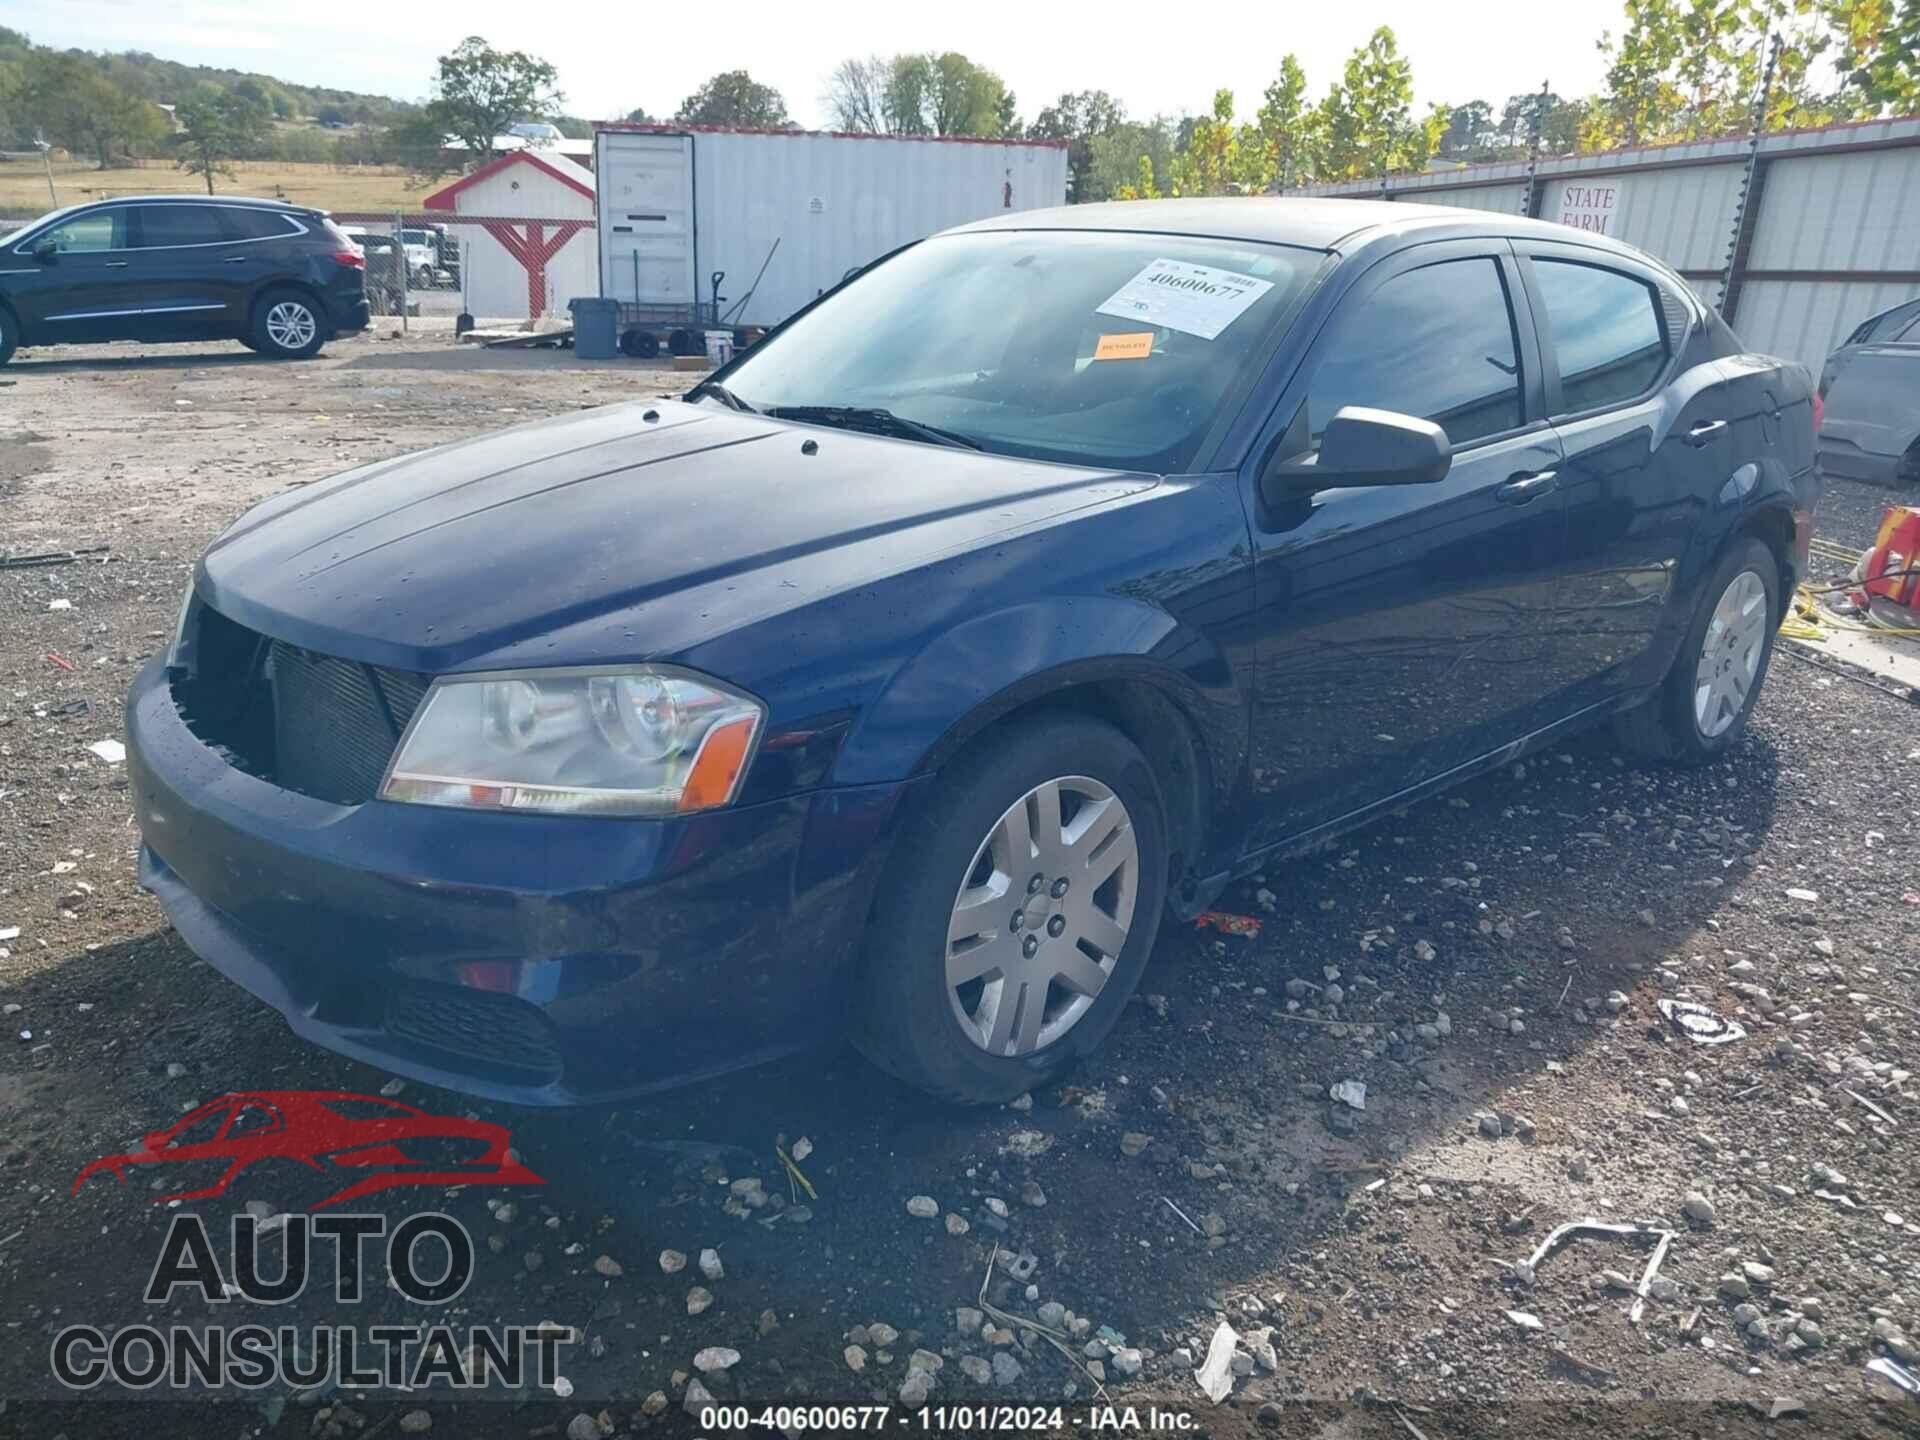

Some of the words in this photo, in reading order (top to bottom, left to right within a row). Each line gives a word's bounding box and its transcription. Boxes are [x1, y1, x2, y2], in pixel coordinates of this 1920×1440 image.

[1563, 187, 1615, 208] STATE
[1563, 213, 1608, 234] FARM
[1147, 273, 1245, 300] 40600677
